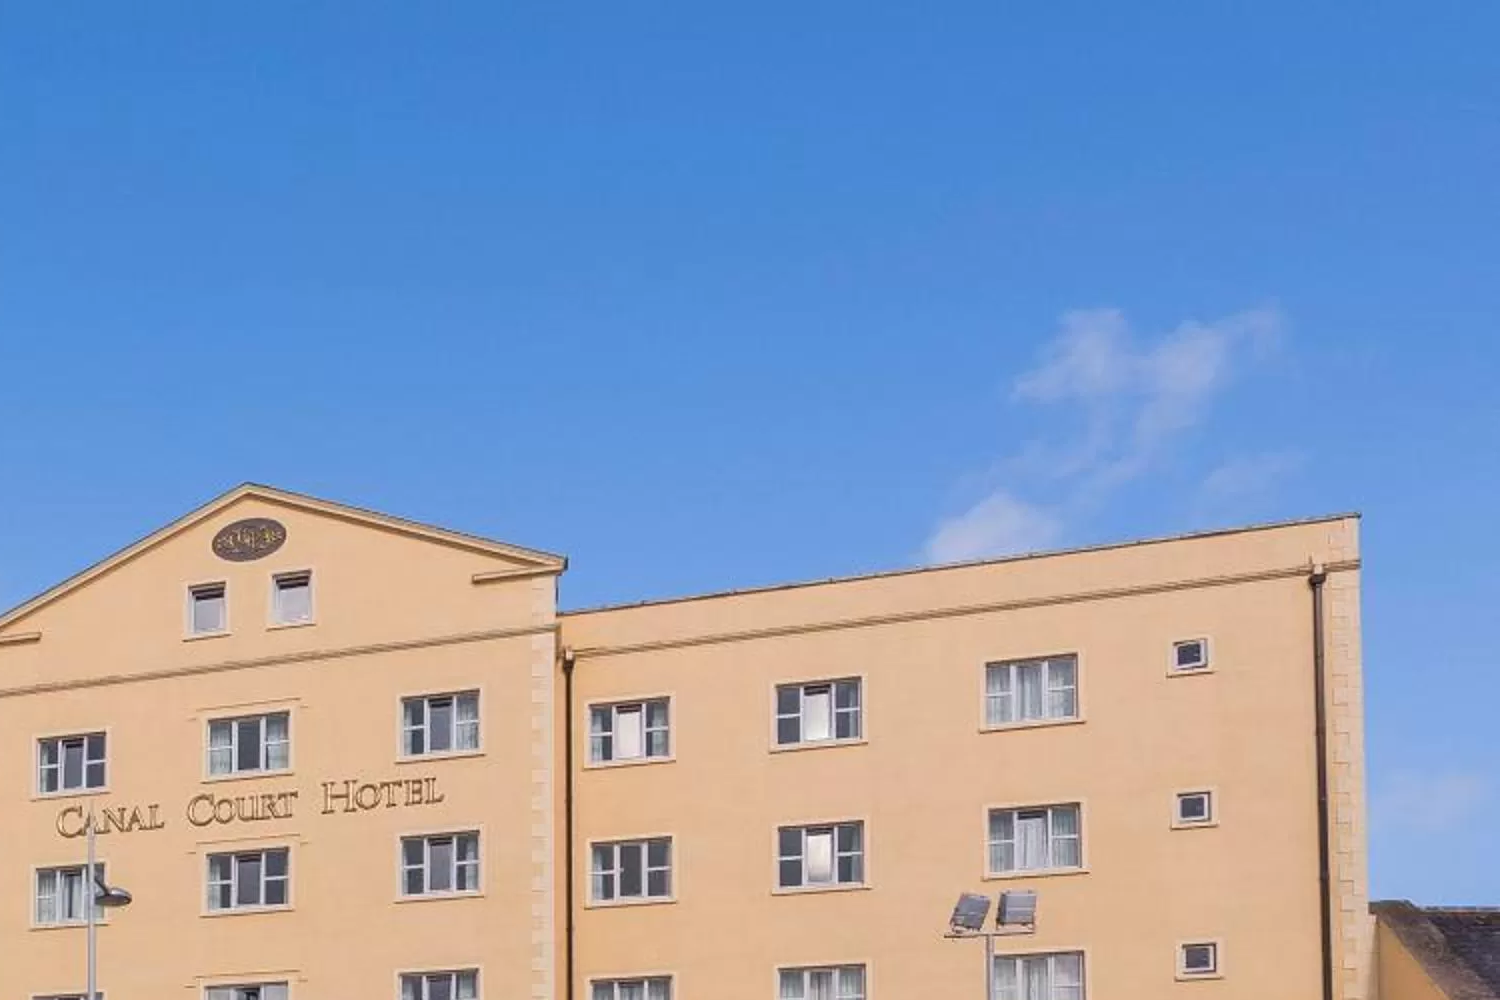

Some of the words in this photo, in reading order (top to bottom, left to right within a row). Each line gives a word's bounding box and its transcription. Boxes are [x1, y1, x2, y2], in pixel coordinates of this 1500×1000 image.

[56, 805, 164, 838] CANAL
[187, 792, 298, 826] COURT
[321, 777, 444, 814] HOTEL
